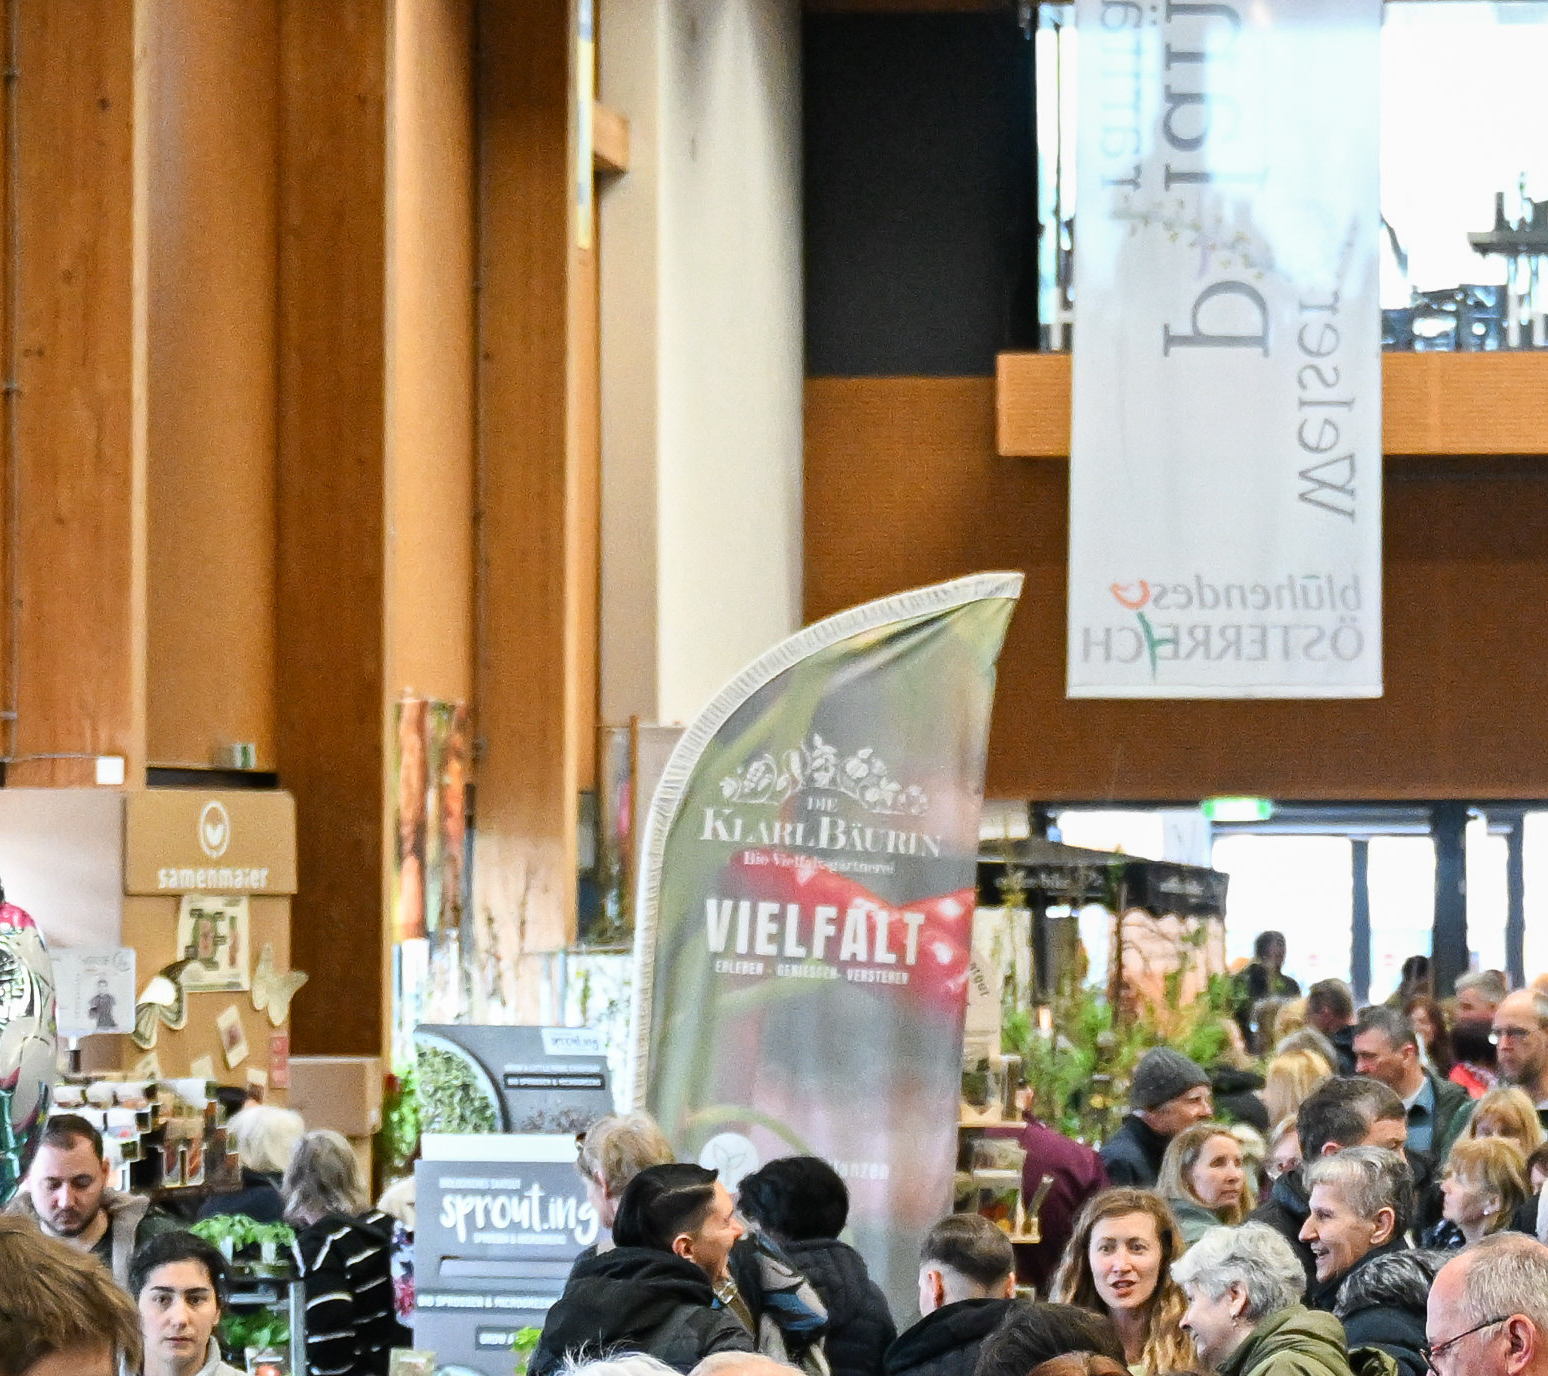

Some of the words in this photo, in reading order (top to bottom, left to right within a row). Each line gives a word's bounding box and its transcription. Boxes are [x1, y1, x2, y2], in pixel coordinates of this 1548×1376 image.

[806, 796, 838, 813] DIE
[158, 867, 269, 890] samenmaier
[706, 897, 926, 967] VIELFALT
